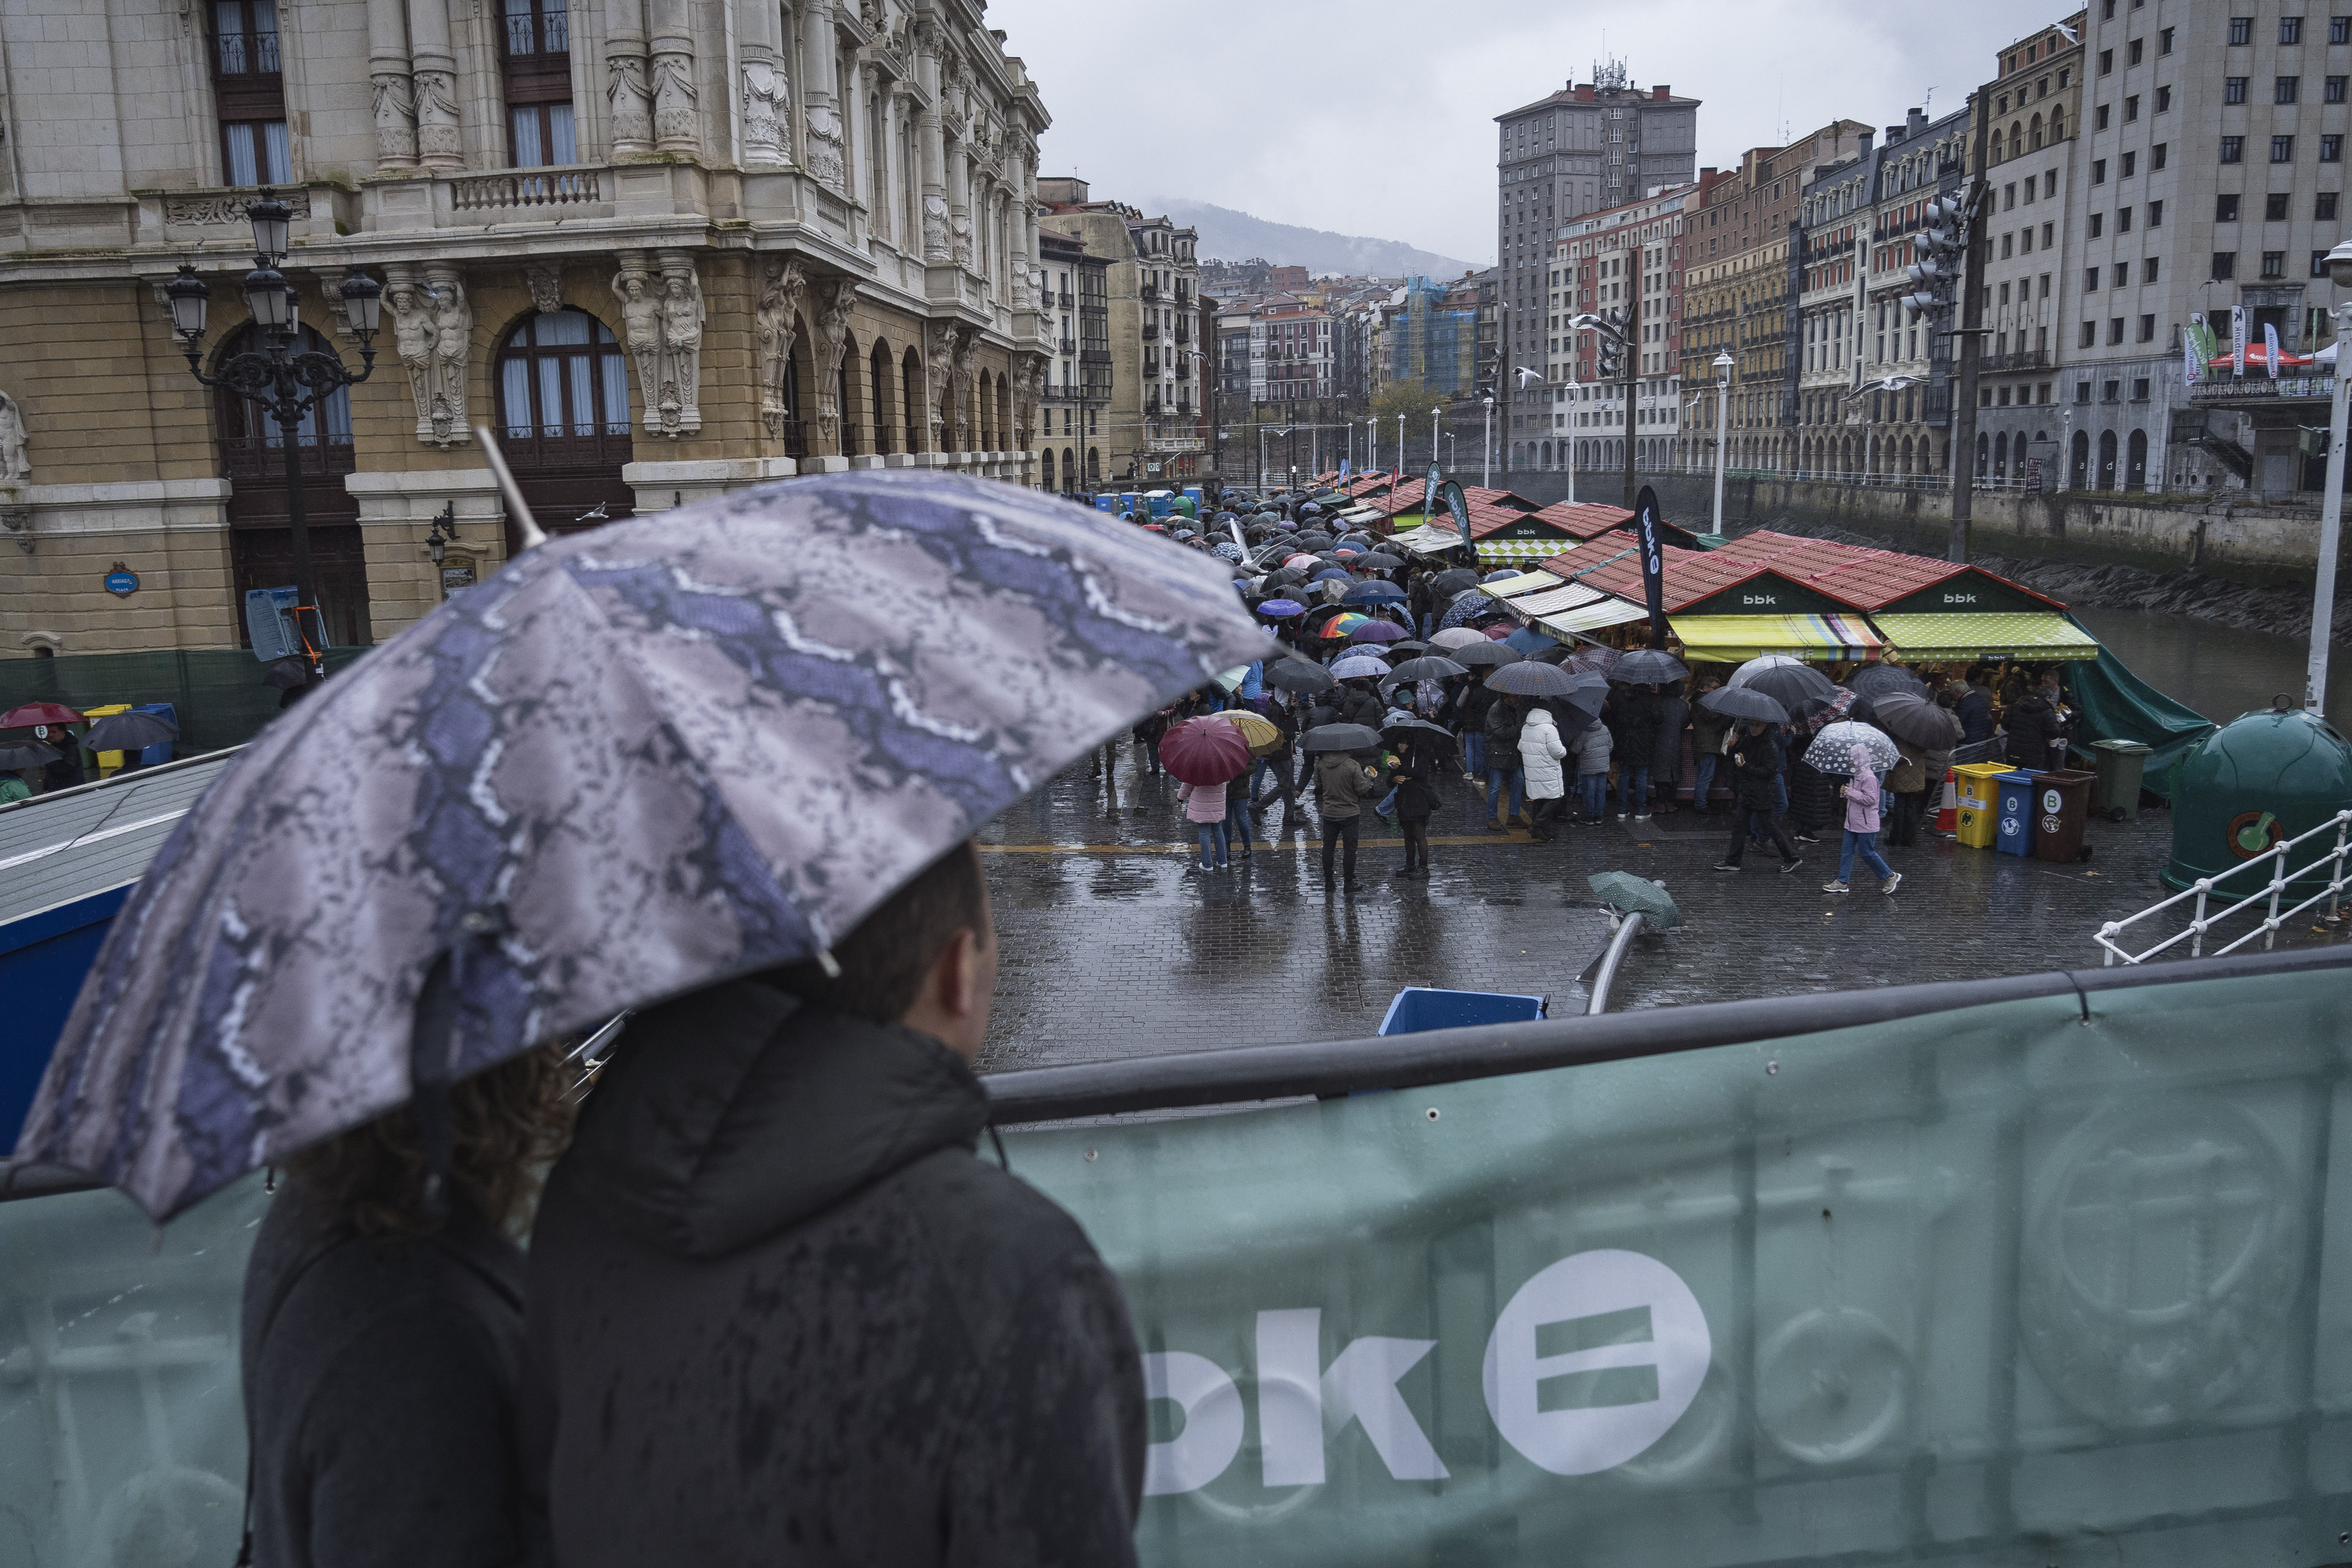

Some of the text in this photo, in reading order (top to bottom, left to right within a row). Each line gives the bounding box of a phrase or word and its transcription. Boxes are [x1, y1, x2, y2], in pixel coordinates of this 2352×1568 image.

[1743, 595, 1777, 604] bbk
[1944, 593, 1976, 603] bbk
[2047, 795, 2057, 808] B
